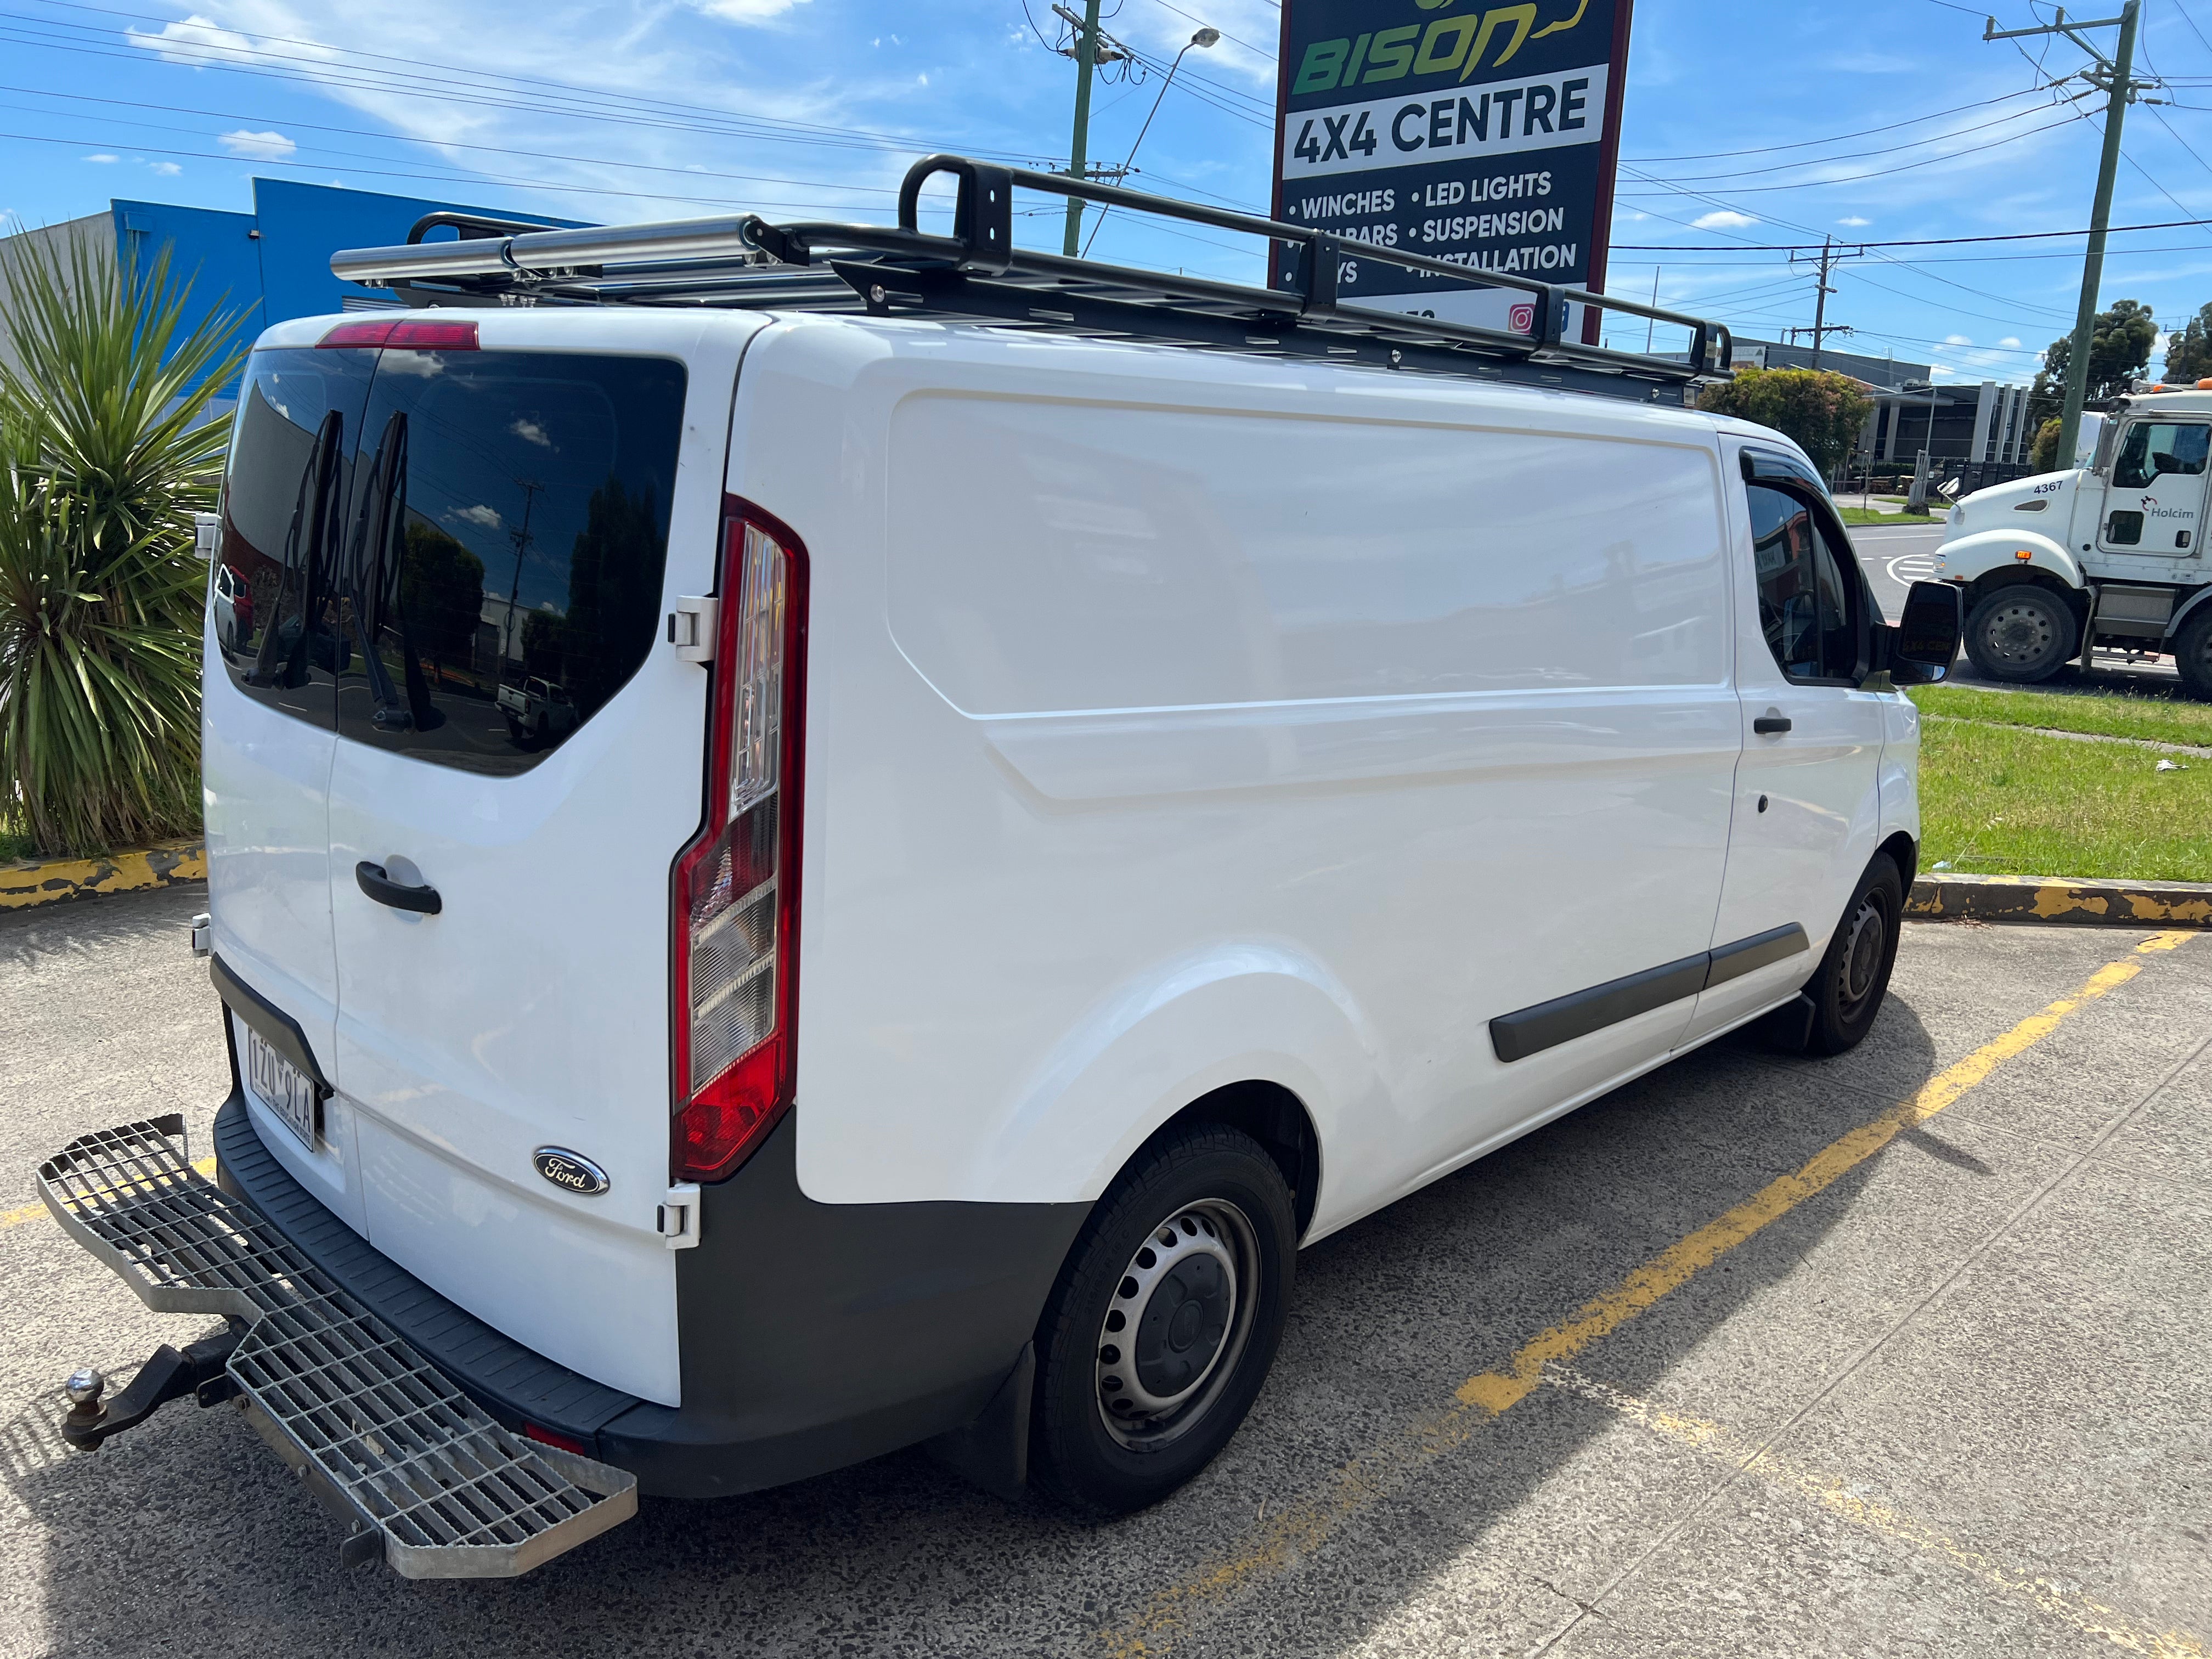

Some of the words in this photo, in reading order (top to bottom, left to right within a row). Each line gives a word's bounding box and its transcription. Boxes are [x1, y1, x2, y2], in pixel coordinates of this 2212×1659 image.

[1291, 3, 1537, 95] BISON
[1294, 111, 1377, 163] 4X4
[1391, 77, 1589, 152] CENTRE
[1302, 189, 1395, 219] WINCHES
[1425, 182, 1465, 207] LED
[1471, 171, 1551, 202] LIGHTS
[1422, 207, 1564, 242] SUSPENSION
[2034, 480, 2063, 494] 4367
[2151, 508, 2194, 519] Holcim
[545, 1158, 586, 1188] Ford
